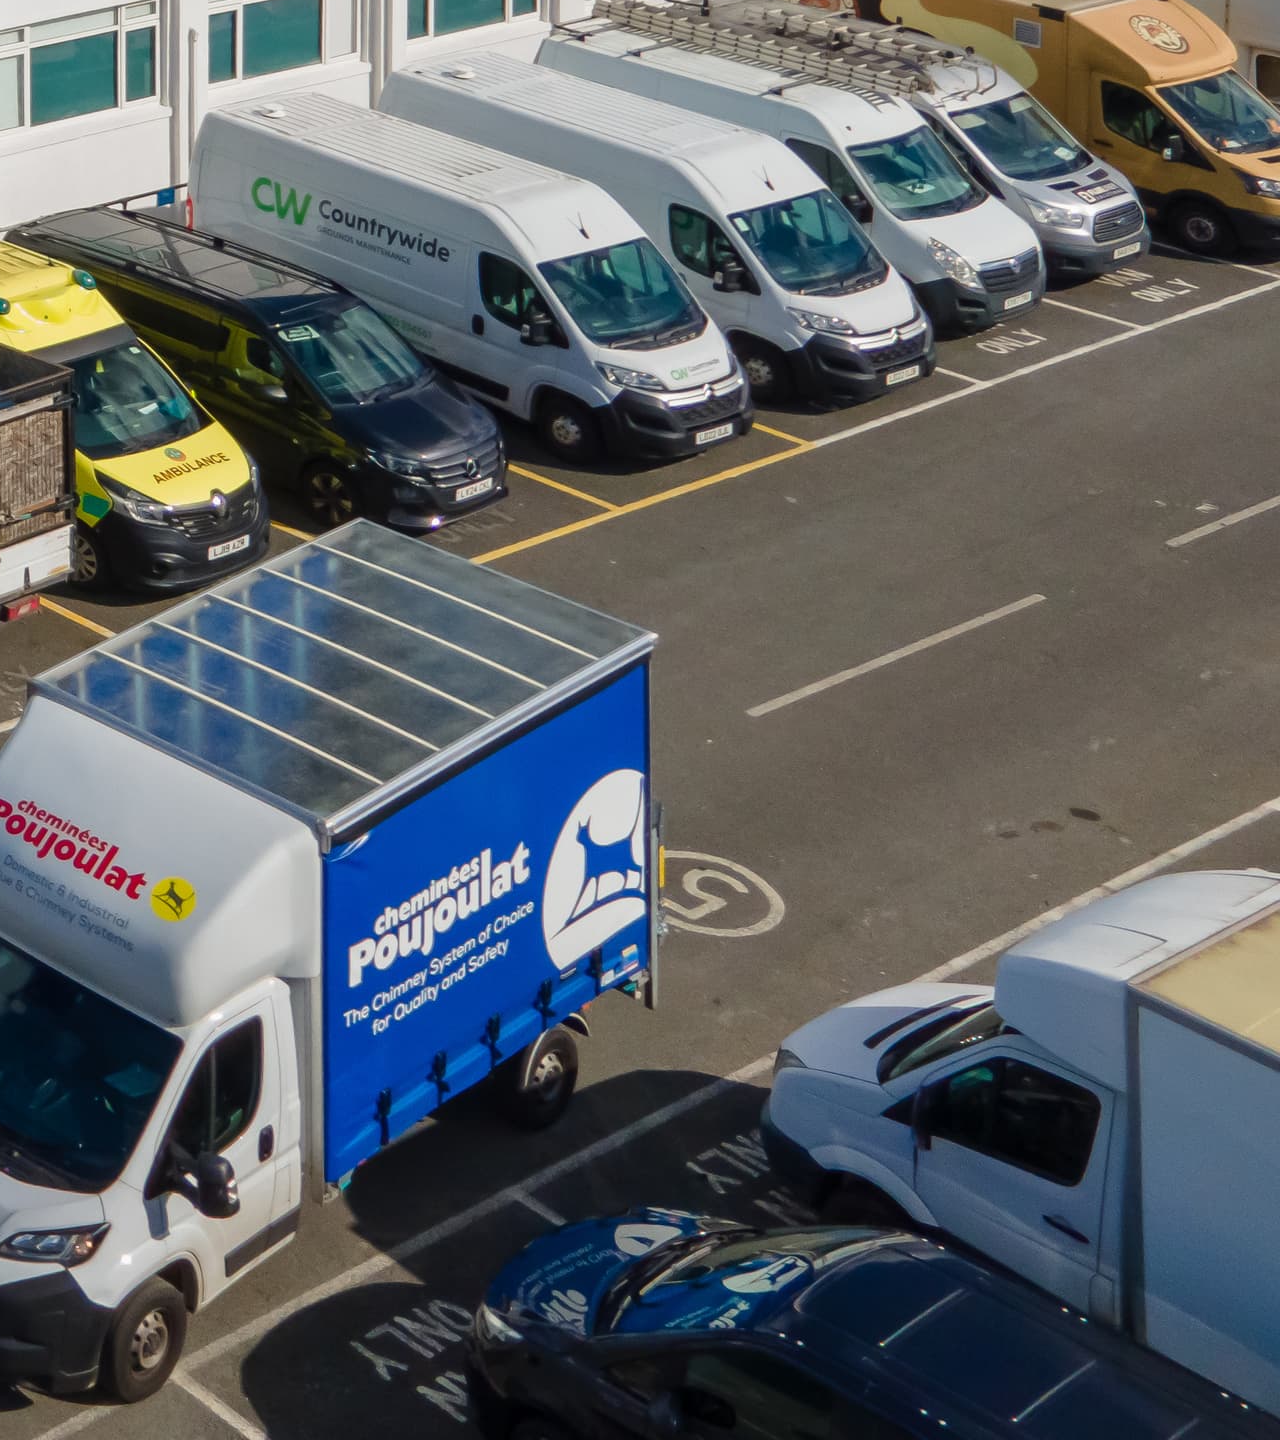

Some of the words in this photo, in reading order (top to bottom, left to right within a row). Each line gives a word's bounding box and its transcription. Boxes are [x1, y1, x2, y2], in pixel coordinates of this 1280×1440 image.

[251, 177, 313, 226] CW
[318, 199, 450, 263] Countrywide
[1094, 268, 1154, 288] VAN
[1131, 278, 1200, 303] ONLY
[976, 328, 1048, 354] ONLY
[153, 452, 231, 485] AMBULANCE
[17, 799, 109, 852] cheminées
[3, 854, 54, 891] Domestic
[68, 888, 130, 930] Industrial
[25, 886, 76, 924] Chimney
[79, 914, 136, 952] Systems
[348, 841, 531, 988] Poujoulat
[374, 857, 480, 935] cheminées
[343, 1005, 370, 1028] The
[372, 969, 428, 1012] Chimney
[429, 938, 476, 976] System
[478, 923, 493, 945] of
[494, 901, 535, 935] Choice
[372, 1013, 392, 1036] for
[394, 983, 440, 1022] Quality
[441, 966, 467, 991] and
[467, 938, 510, 974] Safety
[685, 1128, 772, 1195] NLY
[349, 1299, 475, 1381] ONLY
